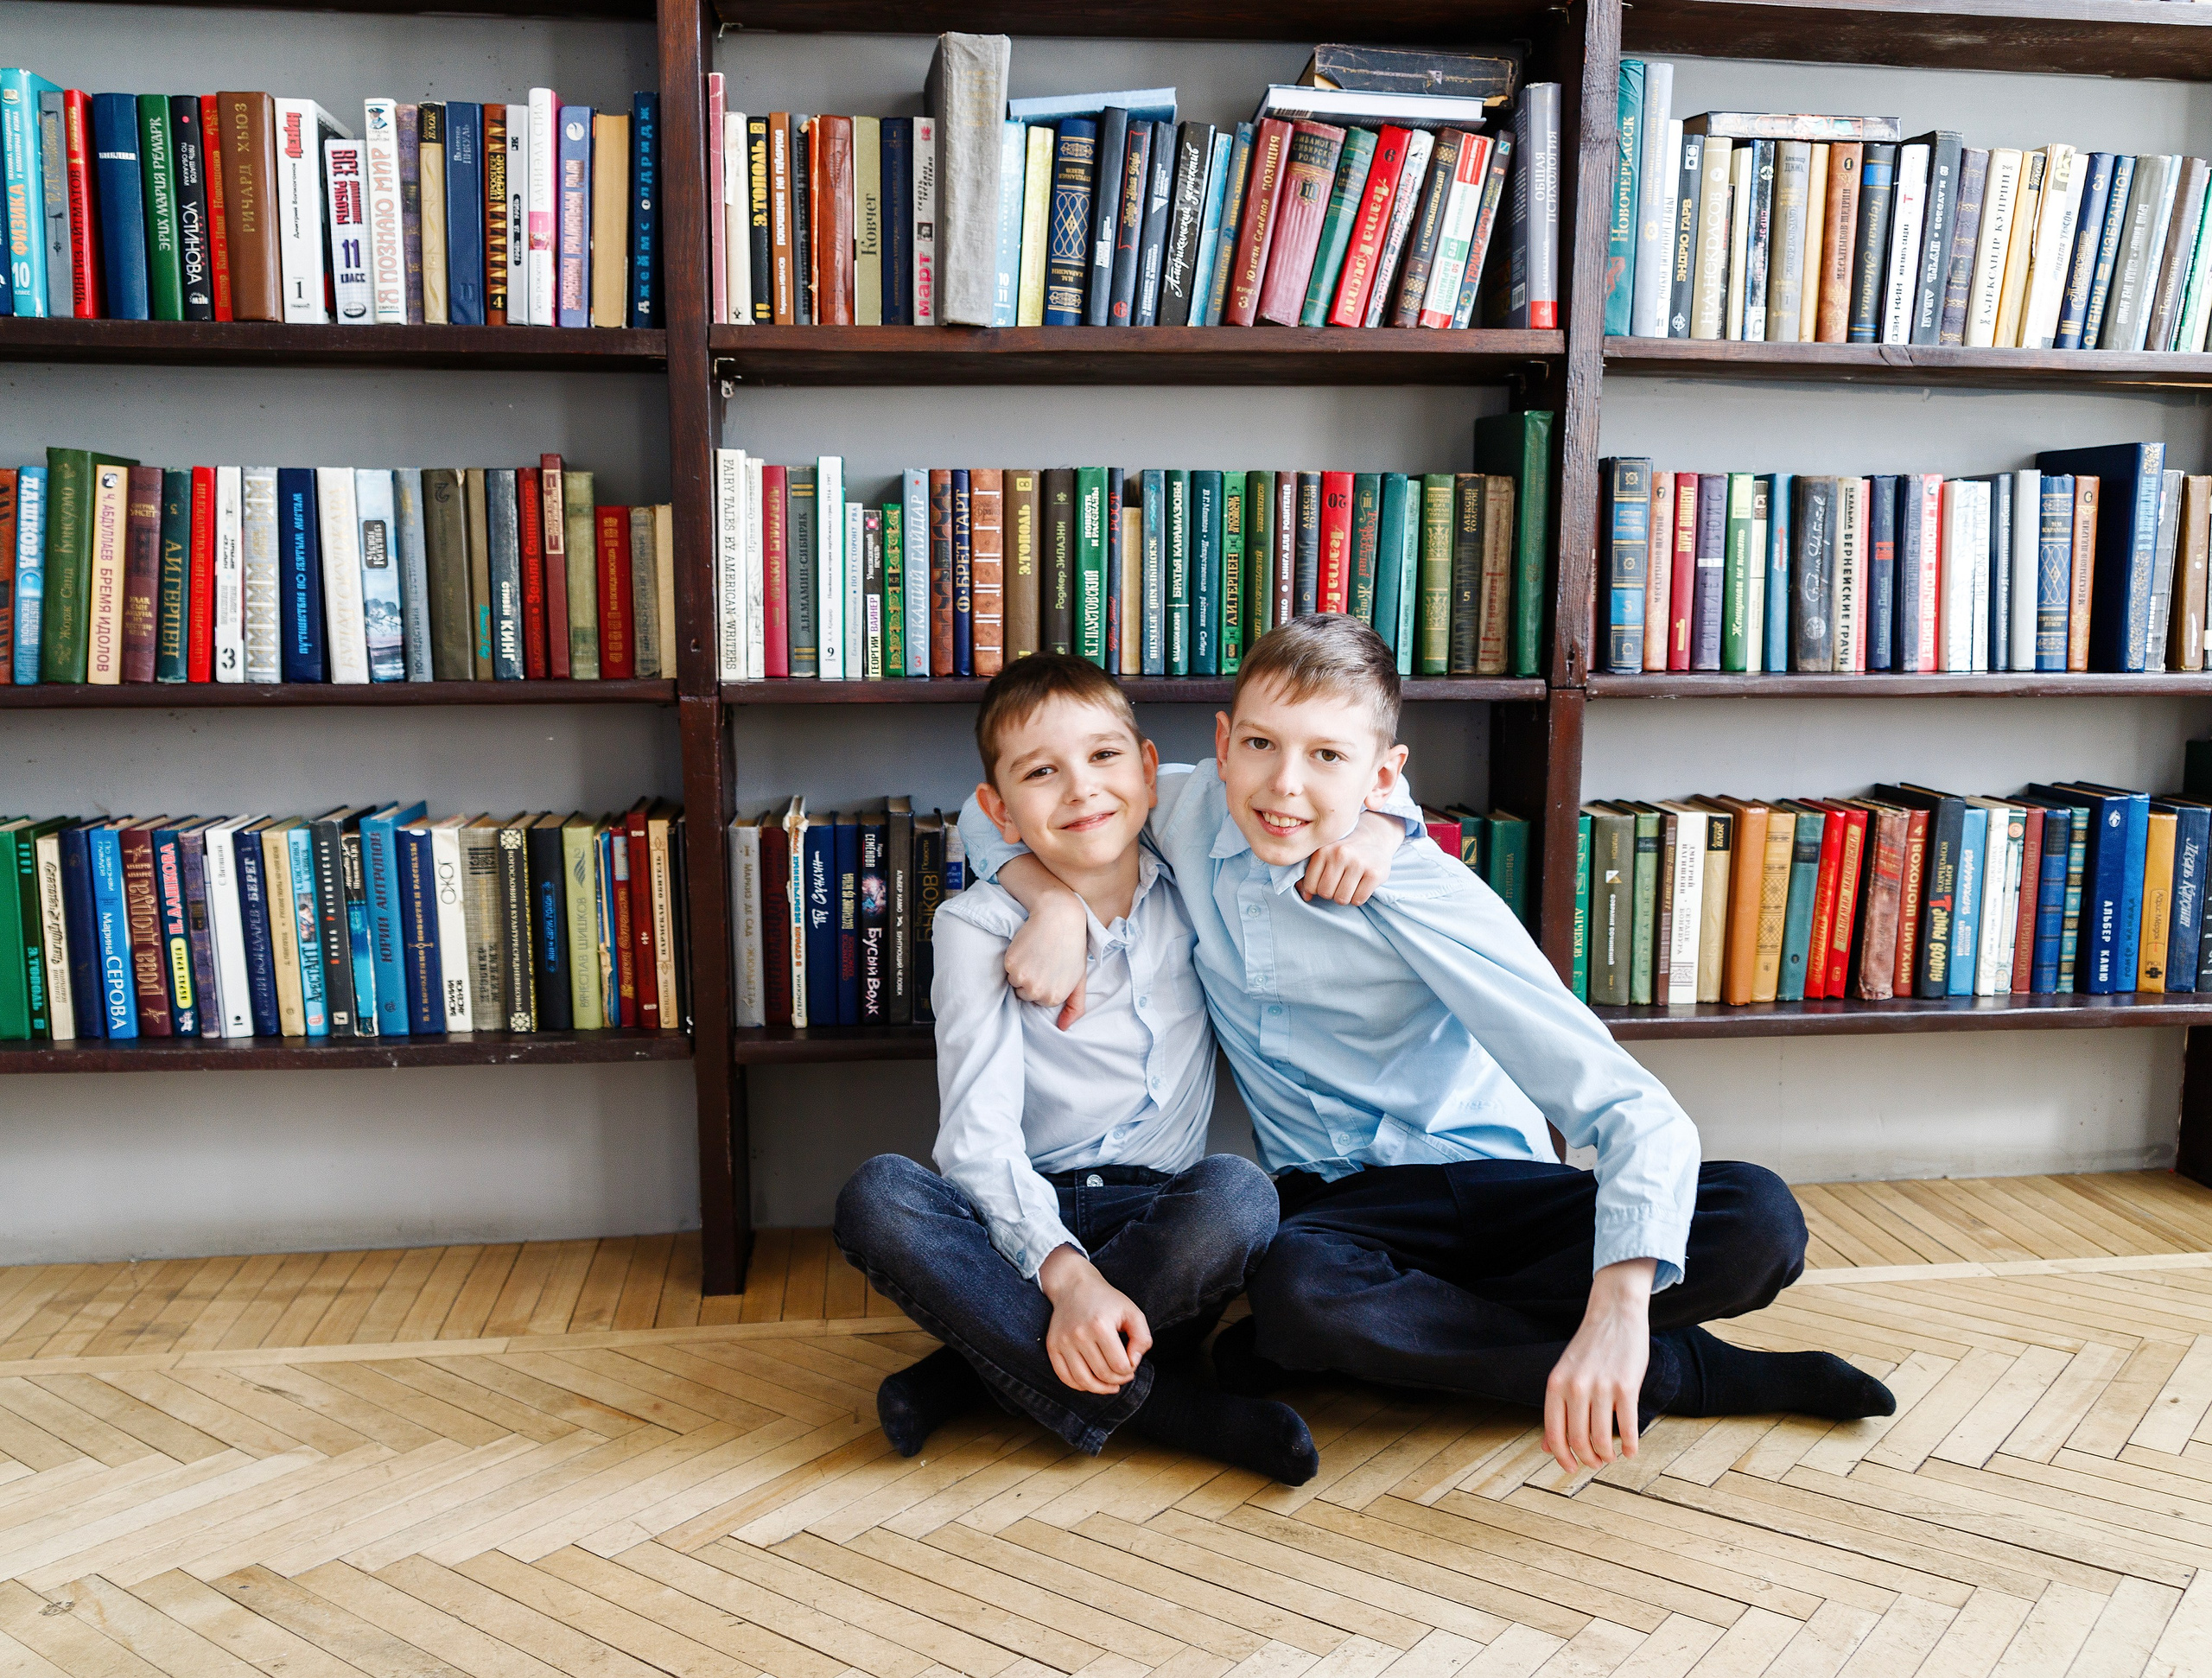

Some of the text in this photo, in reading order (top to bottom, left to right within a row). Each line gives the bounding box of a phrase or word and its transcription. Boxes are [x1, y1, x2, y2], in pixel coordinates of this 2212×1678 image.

[149, 117, 170, 251] ЭРИХ МАРИЯ РЕМАРК
[234, 103, 256, 232] РИЧАРД ХЬЮЗ
[330, 149, 359, 175] ВСЕ
[1262, 134, 1281, 191] ПОЗИЦИЯ
[1535, 152, 1546, 201] ОБЩАЯ
[1545, 130, 1557, 223] ПСИХОЛОГИЯ
[9, 183, 29, 256] ФИЗИКА
[70, 170, 85, 304] ЧИНГИЗ АЙТМАТОВ
[182, 201, 203, 284] УСТИНОВА
[371, 148, 400, 304] Я ПОЗНАЮ МИР
[860, 193, 878, 256] Ковчег
[1164, 142, 1199, 298] Американский детектив
[1677, 198, 1693, 282] ЭНДРЮ ГАРВ
[2101, 167, 2130, 257] ИЗБРАННОЕ
[12, 262, 30, 288] 10
[1342, 178, 1389, 316] Агата Кристи
[917, 252, 932, 317] март
[2159, 256, 2181, 316] Психология
[18, 475, 39, 569] ДАШКОВА
[101, 505, 115, 561] АБДУЛЛАЕВ
[723, 496, 734, 531] TALES
[724, 536, 735, 550] BY
[908, 494, 926, 563] ГАЙДАР
[955, 488, 969, 536] ГАРТ
[1109, 492, 1120, 532] РОСТ
[1173, 480, 1183, 598] БРАТЬЯ КАРАМАЗОВЫ
[1056, 521, 1065, 569] ЗИЛАЗНИ
[99, 568, 113, 613] БРЕМЯ
[296, 573, 307, 589] ПО
[724, 555, 736, 615] AMERICAN
[1839, 533, 1853, 665] ВЕРНЕЙСКИЕ ГРАЧИ
[96, 617, 111, 672] ИДОЛОВ
[500, 620, 516, 662] КИНГ
[725, 620, 736, 670] WRITERS
[244, 856, 259, 903] БЕРЕГ
[575, 897, 588, 950] ШИШКОВ
[1900, 842, 1924, 984] МИХАИЛ ШОЛОХОВ
[2099, 900, 2113, 982] АЛЬБЕР КАМЮ
[102, 912, 127, 1030] Марина СЕРОВА
